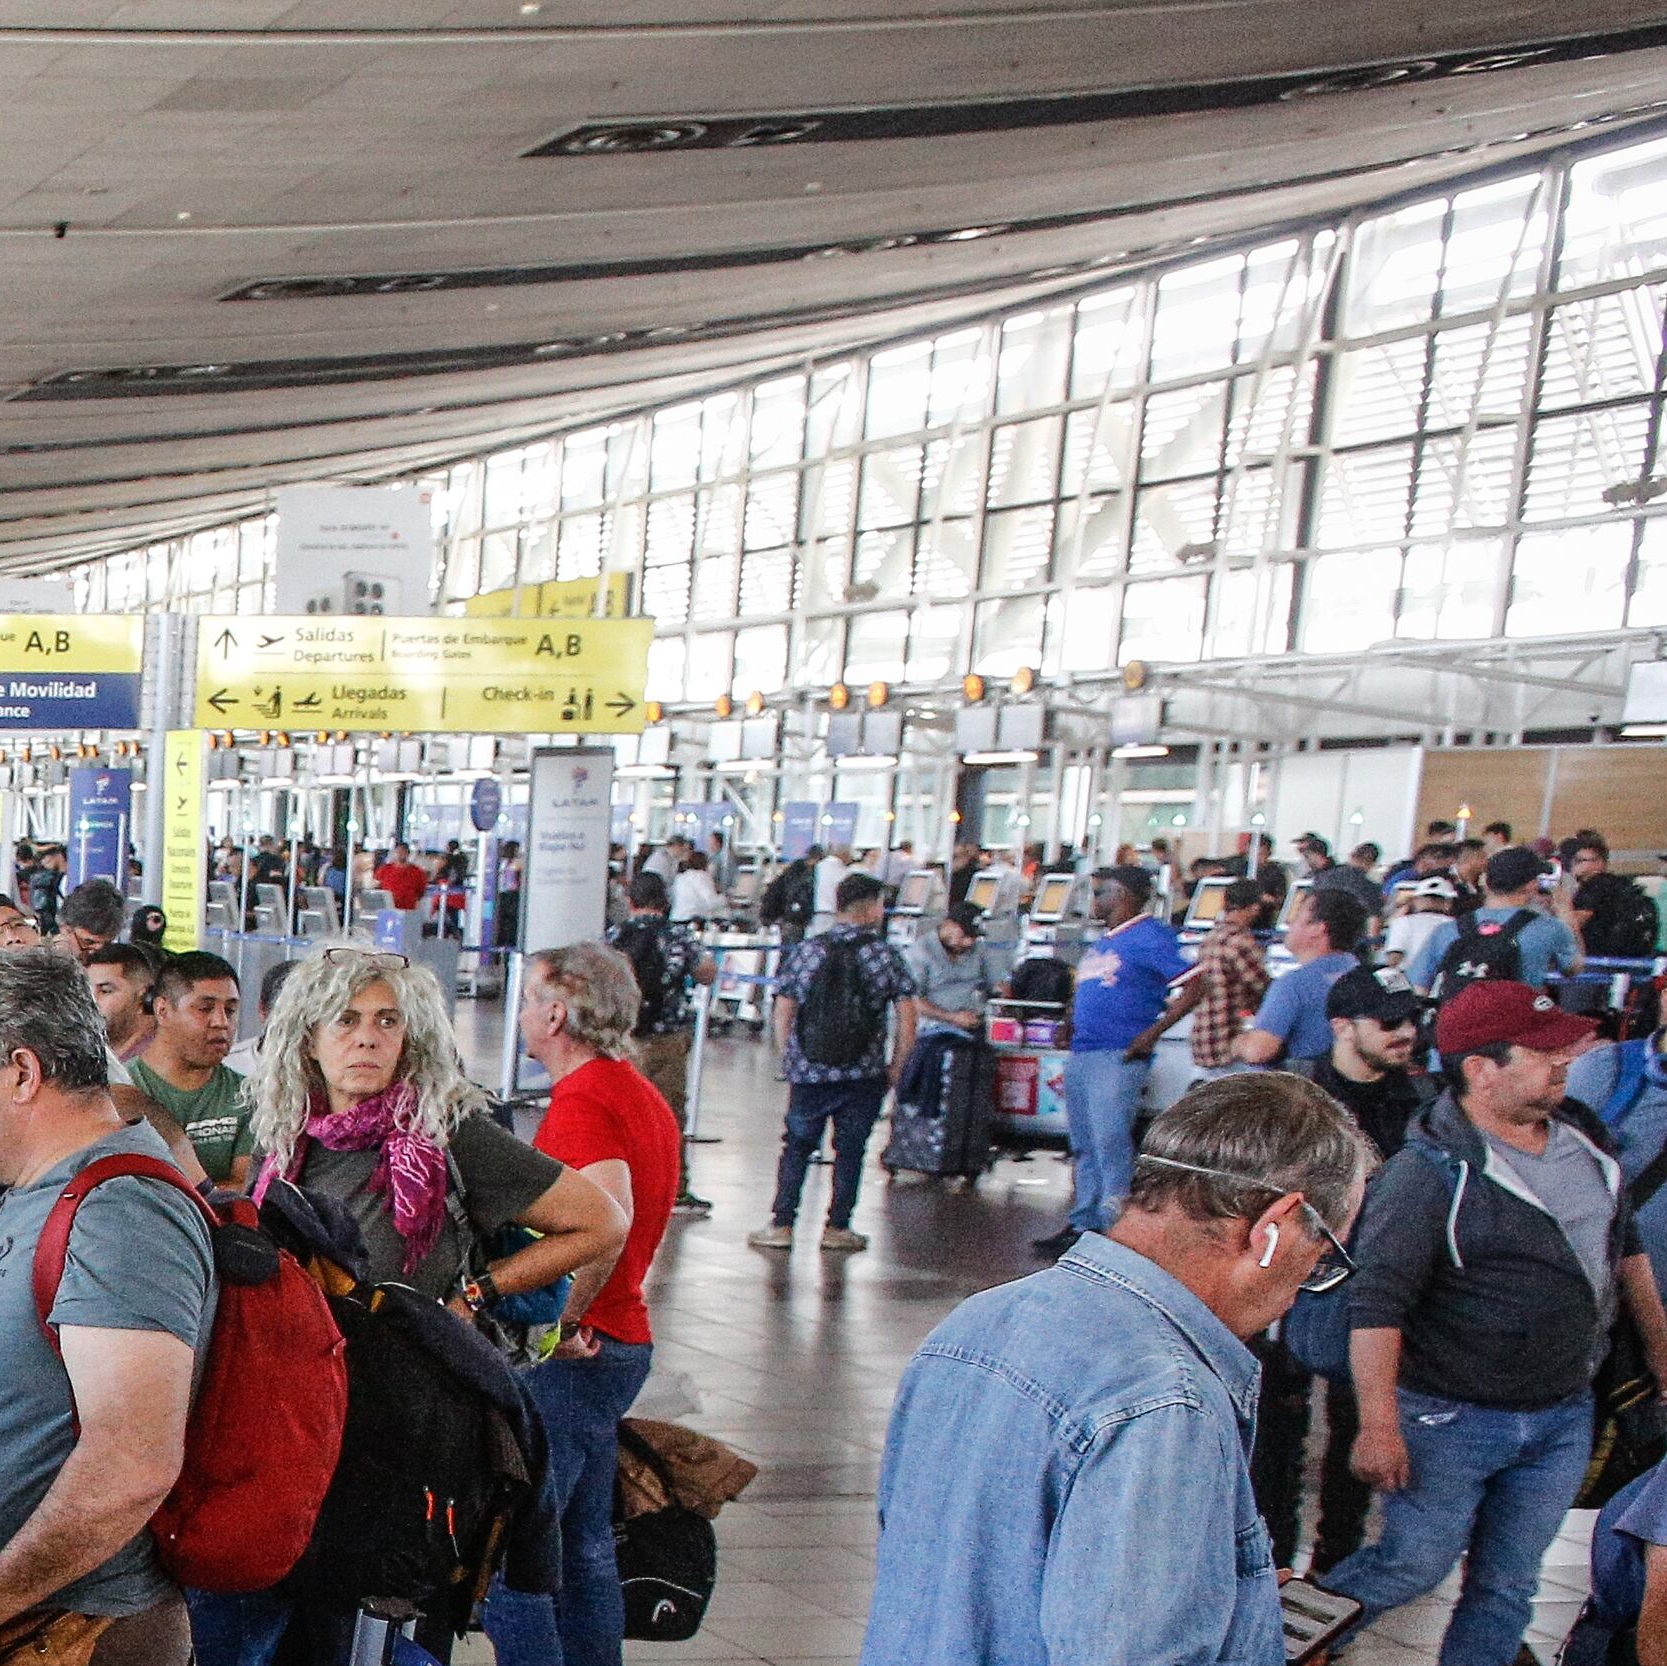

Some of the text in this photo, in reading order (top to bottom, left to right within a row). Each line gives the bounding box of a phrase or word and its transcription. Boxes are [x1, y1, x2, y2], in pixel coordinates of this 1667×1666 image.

[24, 630, 70, 654] A,B
[295, 627, 354, 643] Salidas
[534, 633, 582, 660] A,B
[294, 648, 375, 663] Departures
[9, 680, 96, 700] Movilidad
[331, 684, 555, 702] Llegadas Check-in
[331, 706, 389, 720] Arrivals
